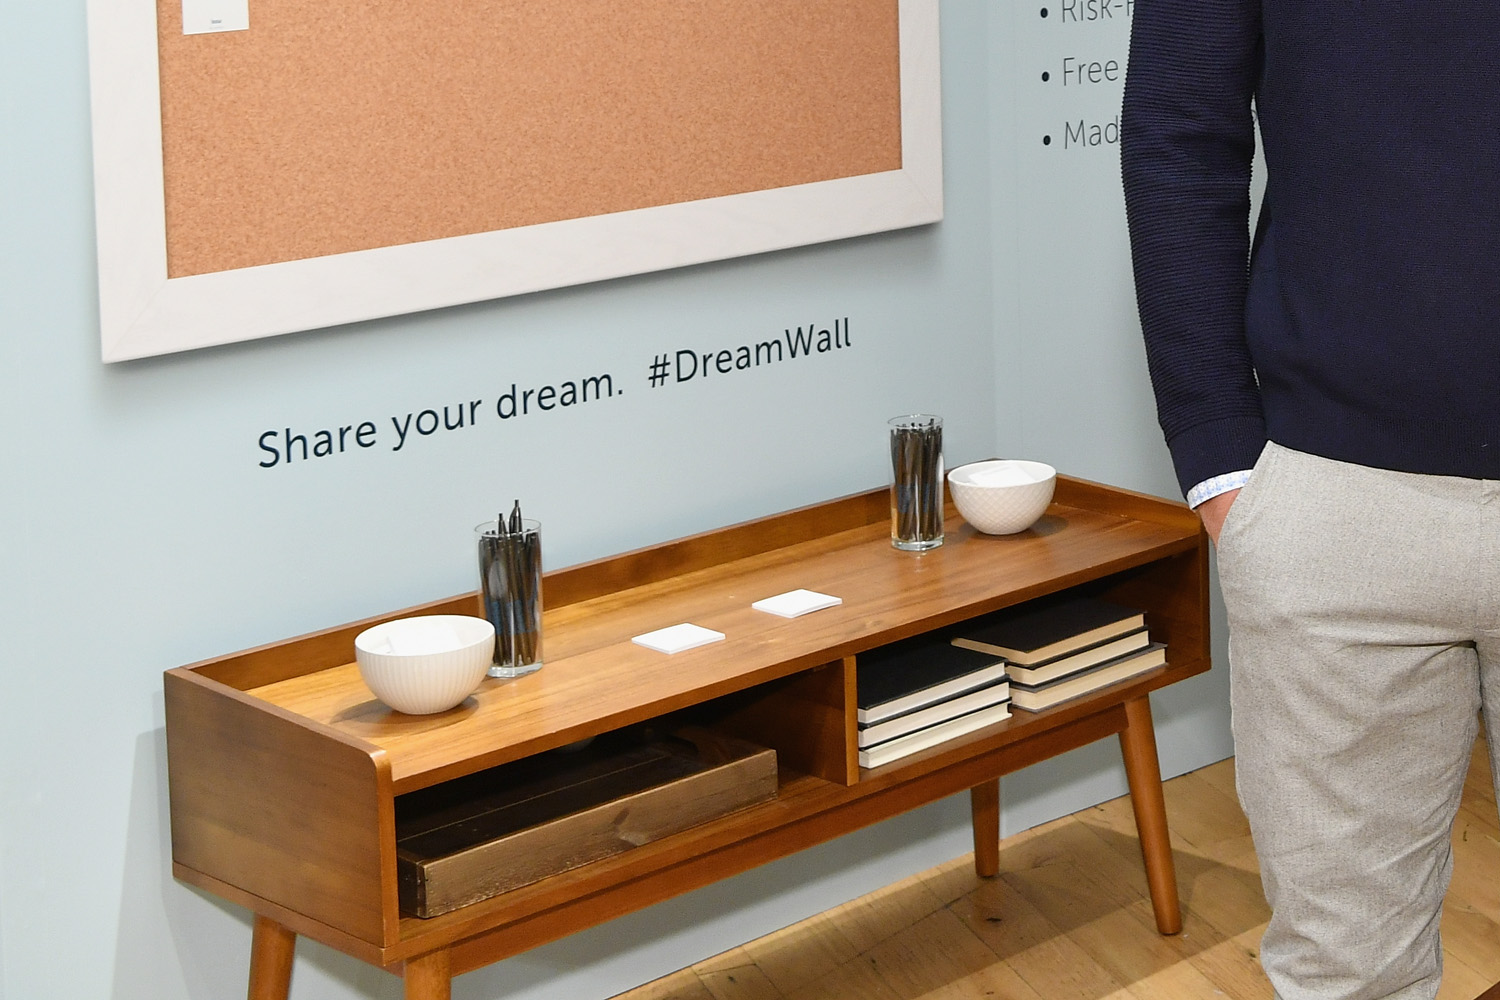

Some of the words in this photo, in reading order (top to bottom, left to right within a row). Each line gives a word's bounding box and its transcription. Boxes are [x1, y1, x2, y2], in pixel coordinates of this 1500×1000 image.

[1064, 58, 1118, 86] Free
[1064, 115, 1120, 149] Mad
[259, 422, 376, 467] Share
[392, 400, 481, 451] your
[497, 374, 622, 419] dream.
[649, 318, 850, 388] #DreamWall
